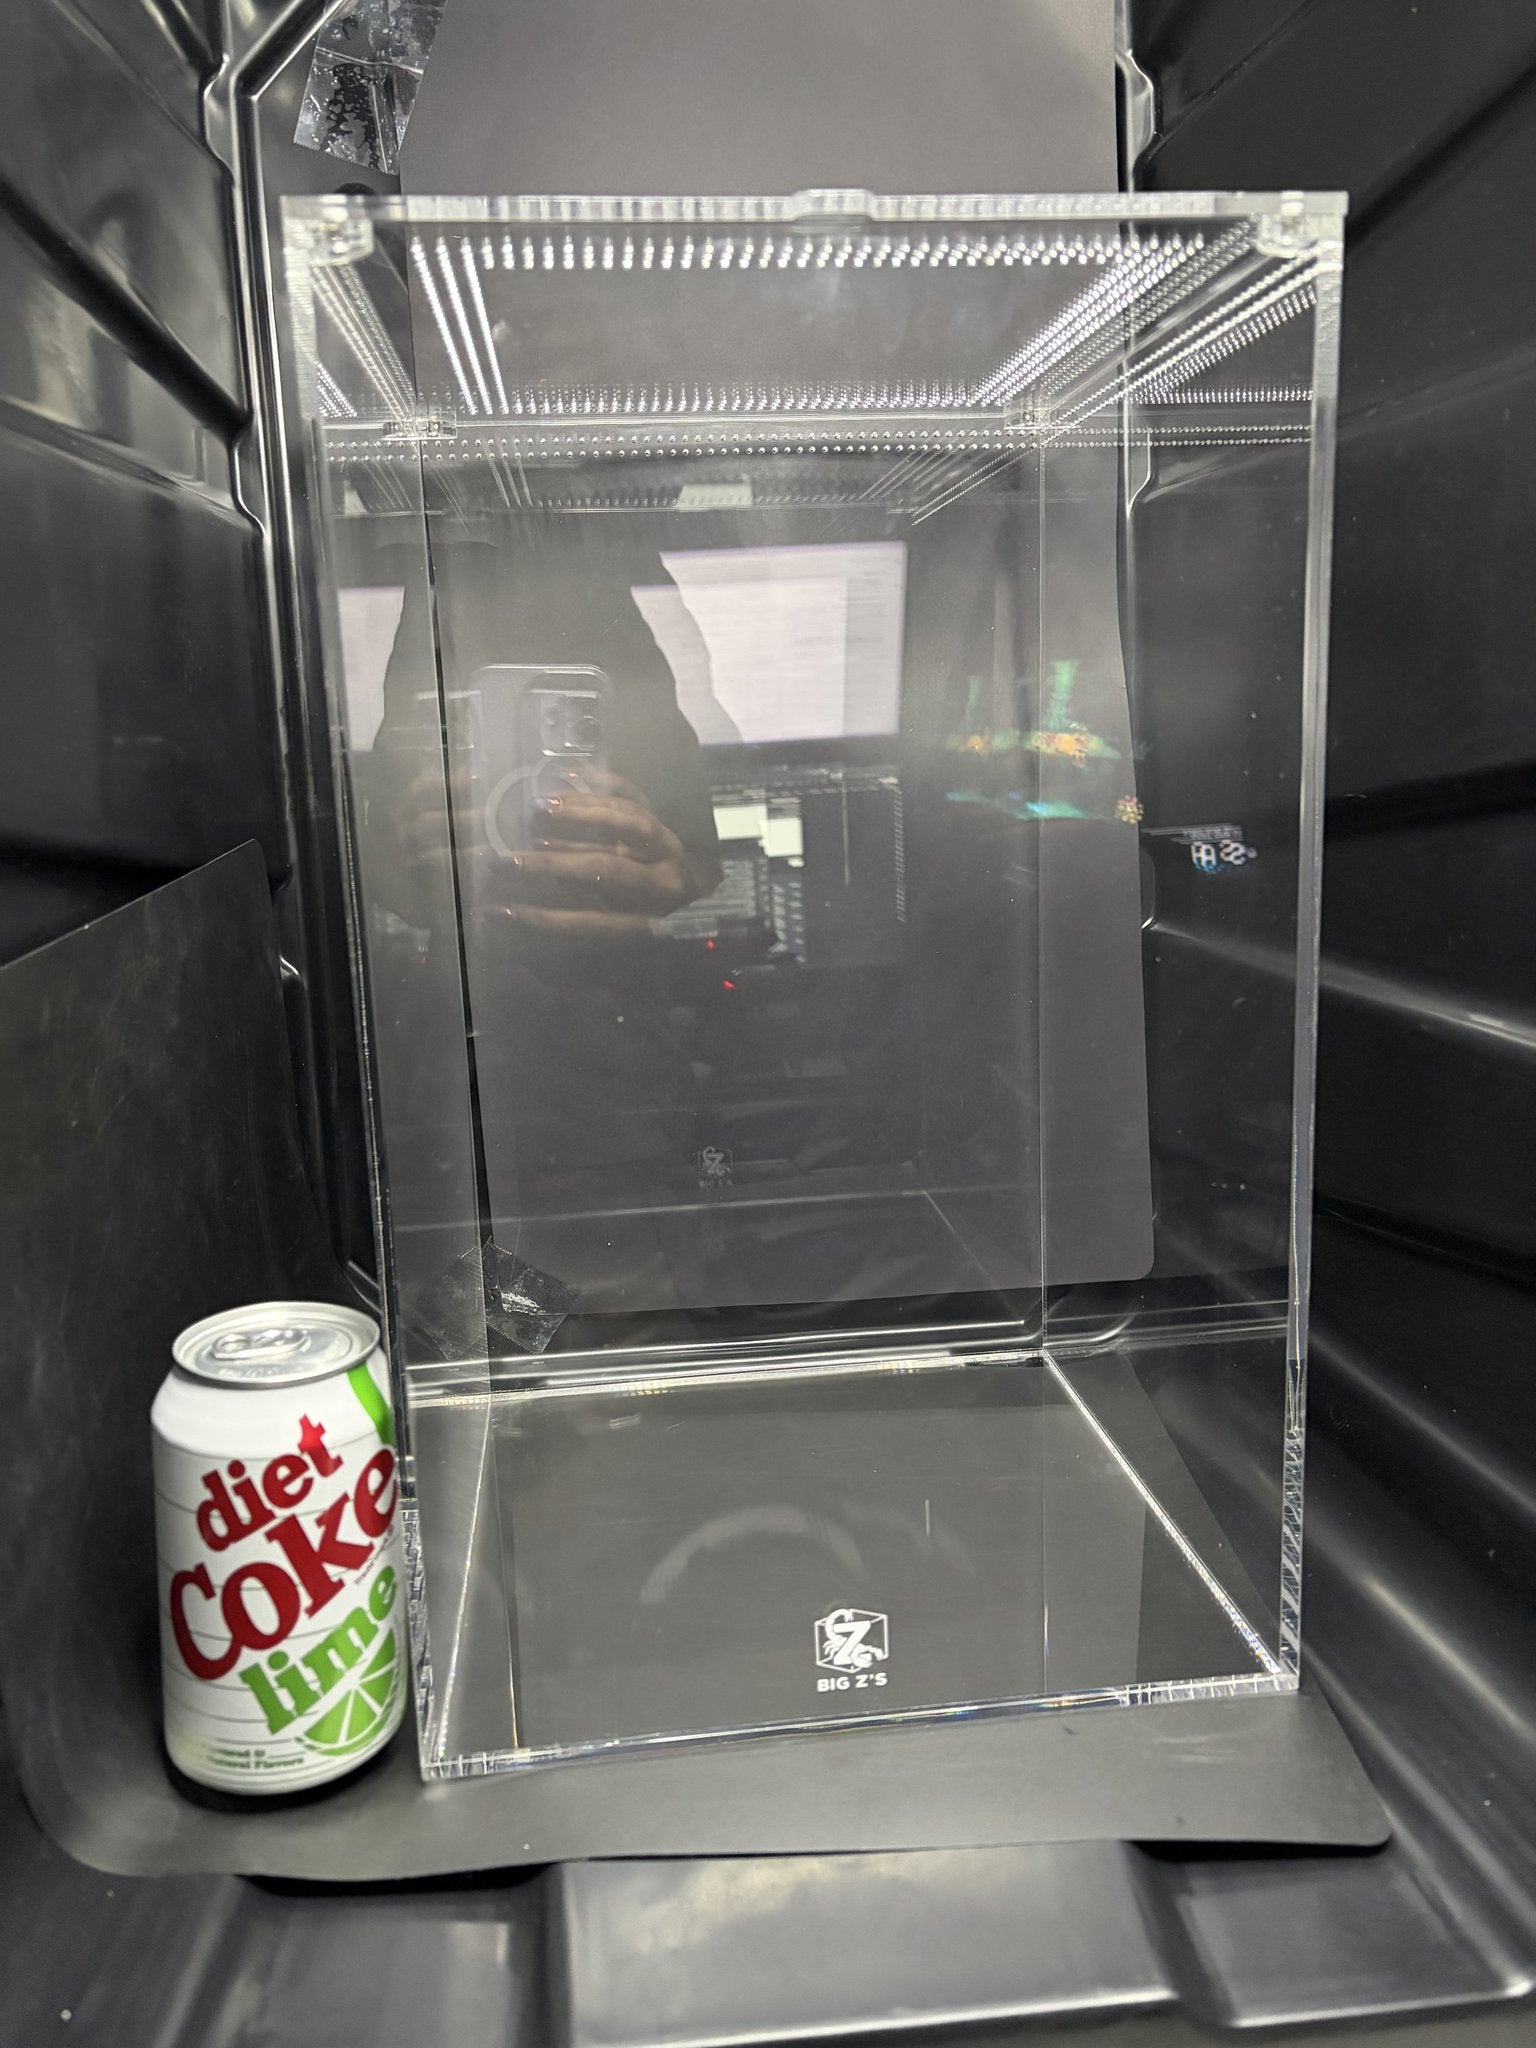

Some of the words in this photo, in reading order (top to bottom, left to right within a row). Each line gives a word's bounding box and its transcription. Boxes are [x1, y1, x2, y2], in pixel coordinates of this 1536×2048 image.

[197, 1413, 344, 1552] diet
[170, 1449, 397, 1680] Coke
[239, 1566, 397, 1735] lime
[817, 1676, 850, 1692] BIG
[855, 1672, 888, 1688] Z'S
